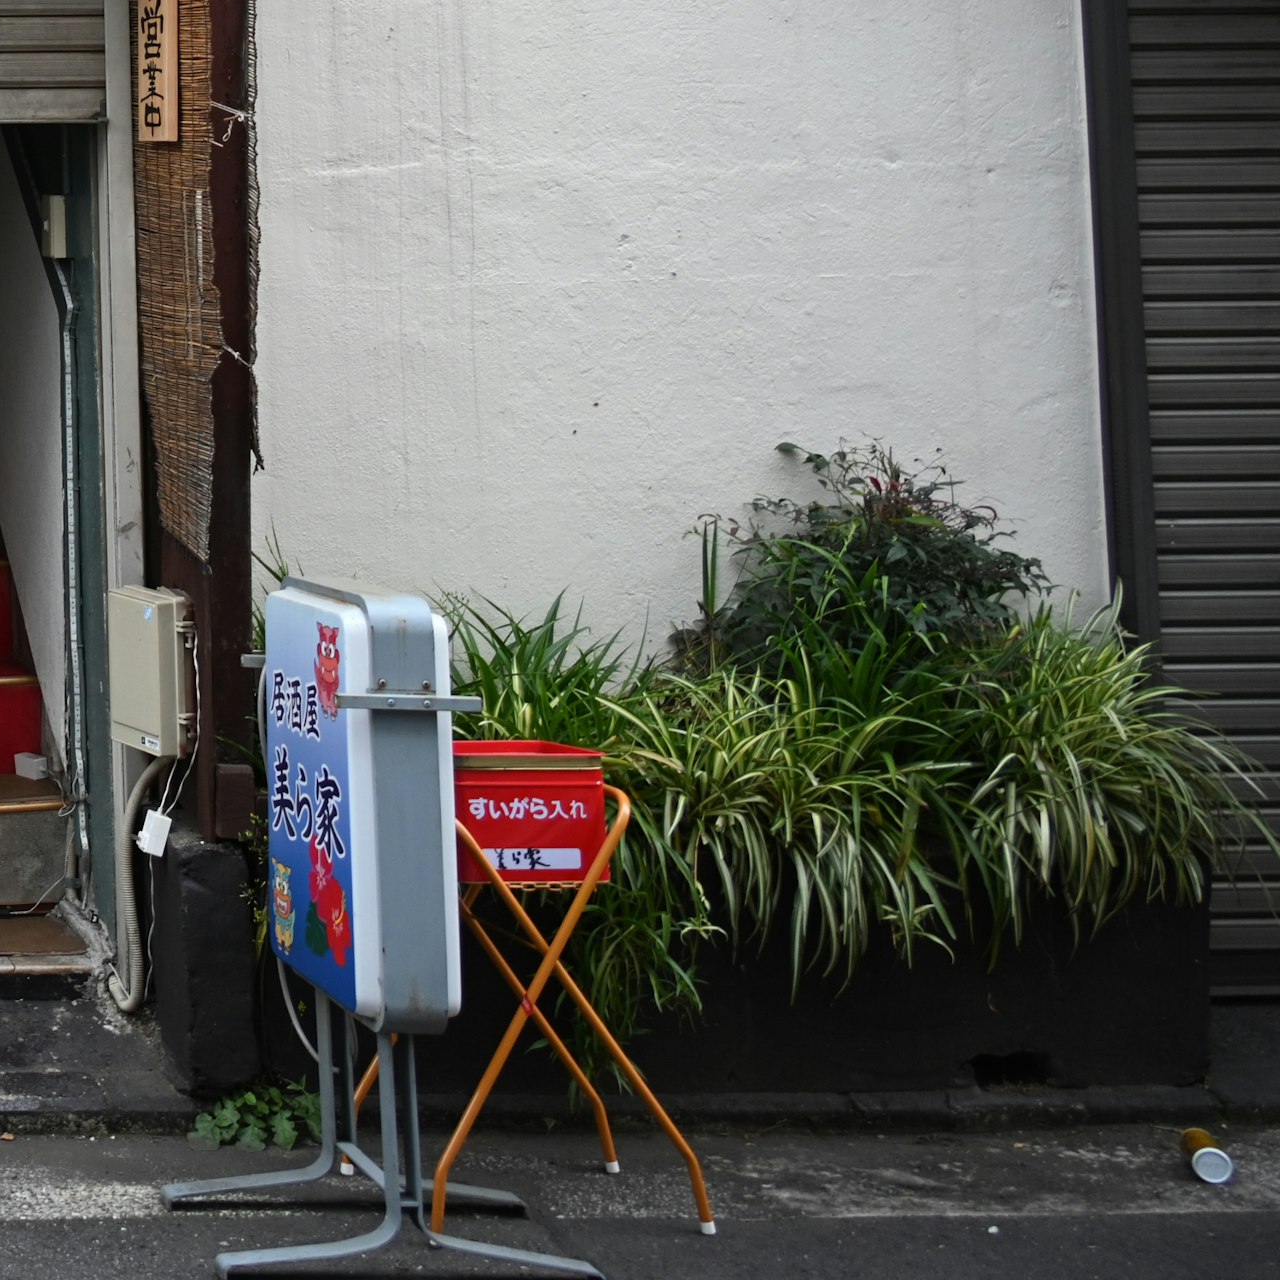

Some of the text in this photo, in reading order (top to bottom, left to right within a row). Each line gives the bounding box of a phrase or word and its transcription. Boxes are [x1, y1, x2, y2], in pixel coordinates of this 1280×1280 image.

[270, 671, 321, 741] 居酒屋
[272, 745, 345, 860] 美ら家
[468, 797, 588, 820] すいがら入れ
